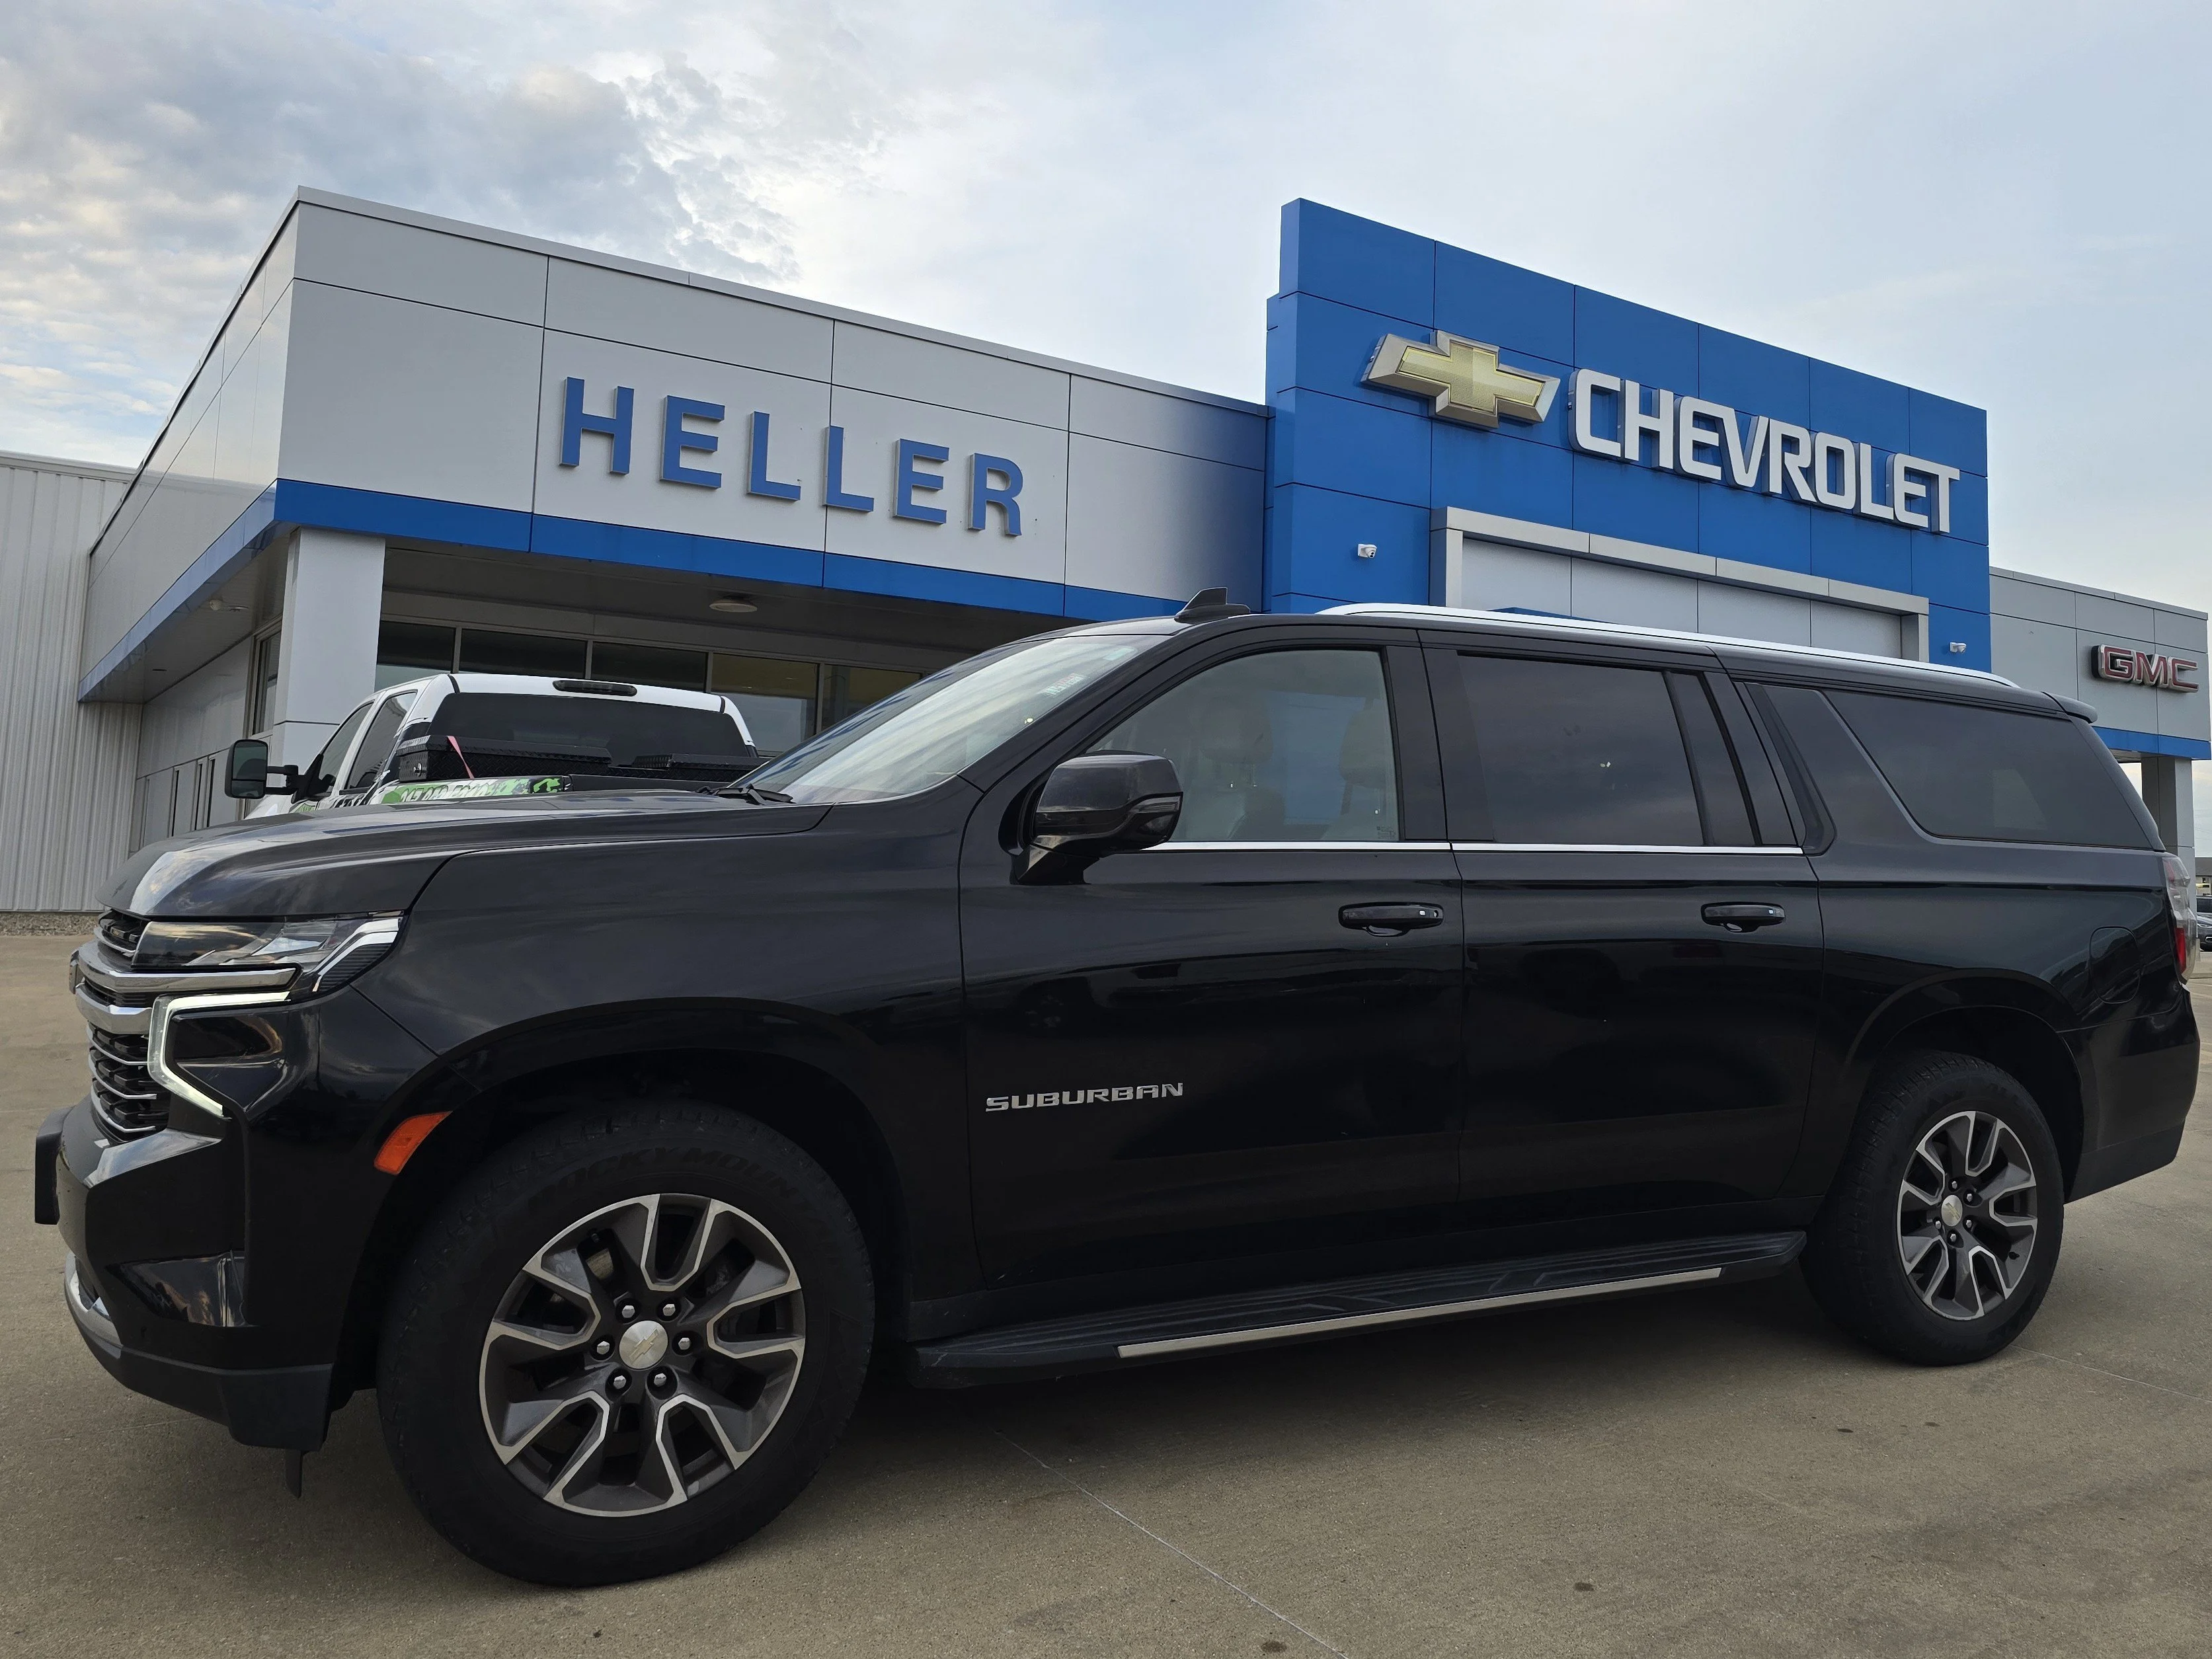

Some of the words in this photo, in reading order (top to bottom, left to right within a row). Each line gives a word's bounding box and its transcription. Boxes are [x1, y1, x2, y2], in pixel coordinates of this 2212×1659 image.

[559, 376, 1024, 537] HELLER
[1567, 367, 1961, 533] CHEVROLET
[2092, 644, 2199, 693] GMC
[985, 1082, 1183, 1112] SUBURBAN
